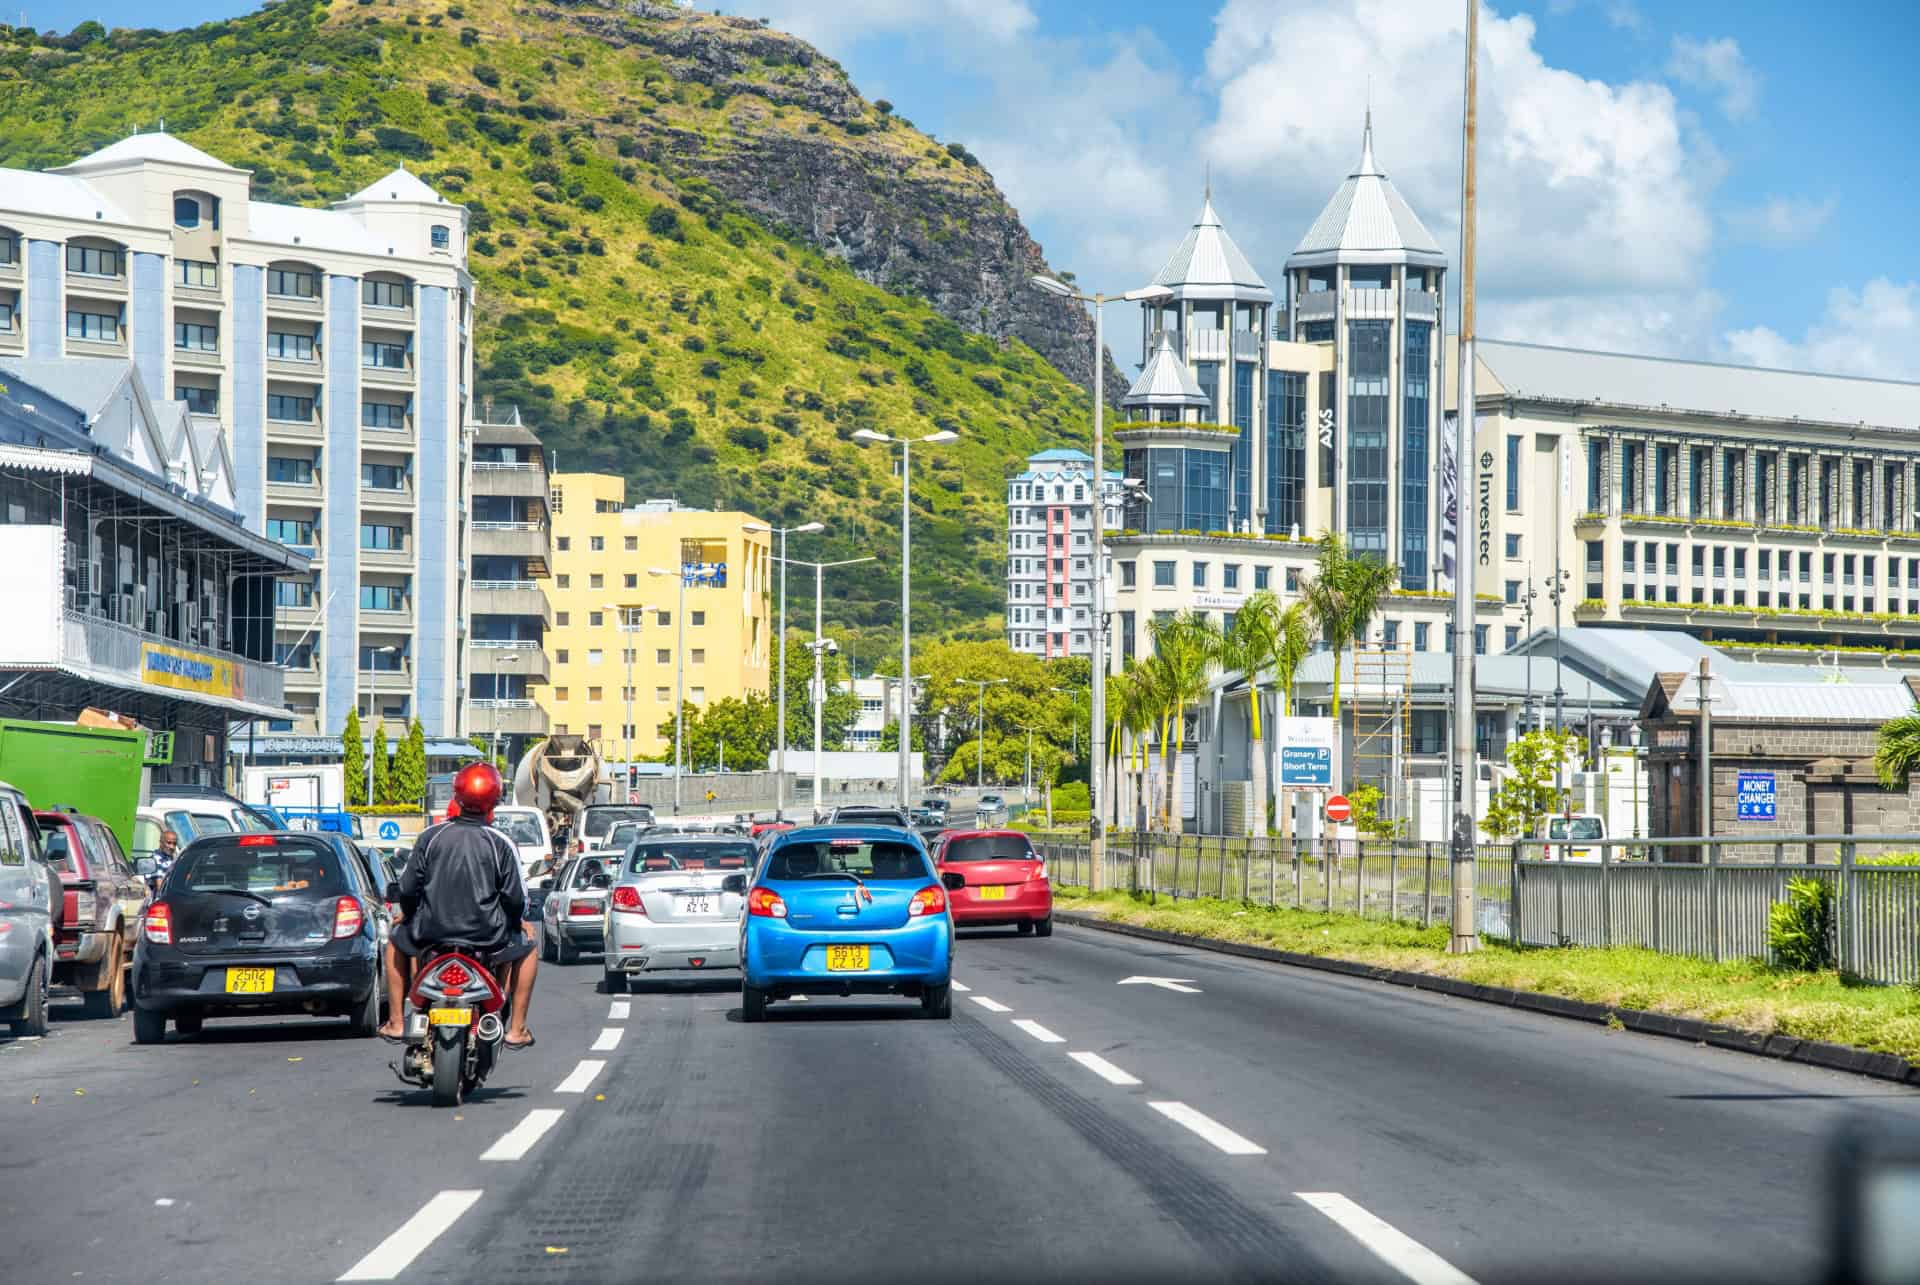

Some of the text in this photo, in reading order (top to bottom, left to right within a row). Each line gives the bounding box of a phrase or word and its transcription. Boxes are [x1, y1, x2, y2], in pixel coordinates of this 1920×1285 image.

[1479, 473, 1493, 566] Investec
[1283, 750, 1316, 759] Granary
[1743, 780, 1770, 791] MONEY
[851, 957, 864, 968] 12
